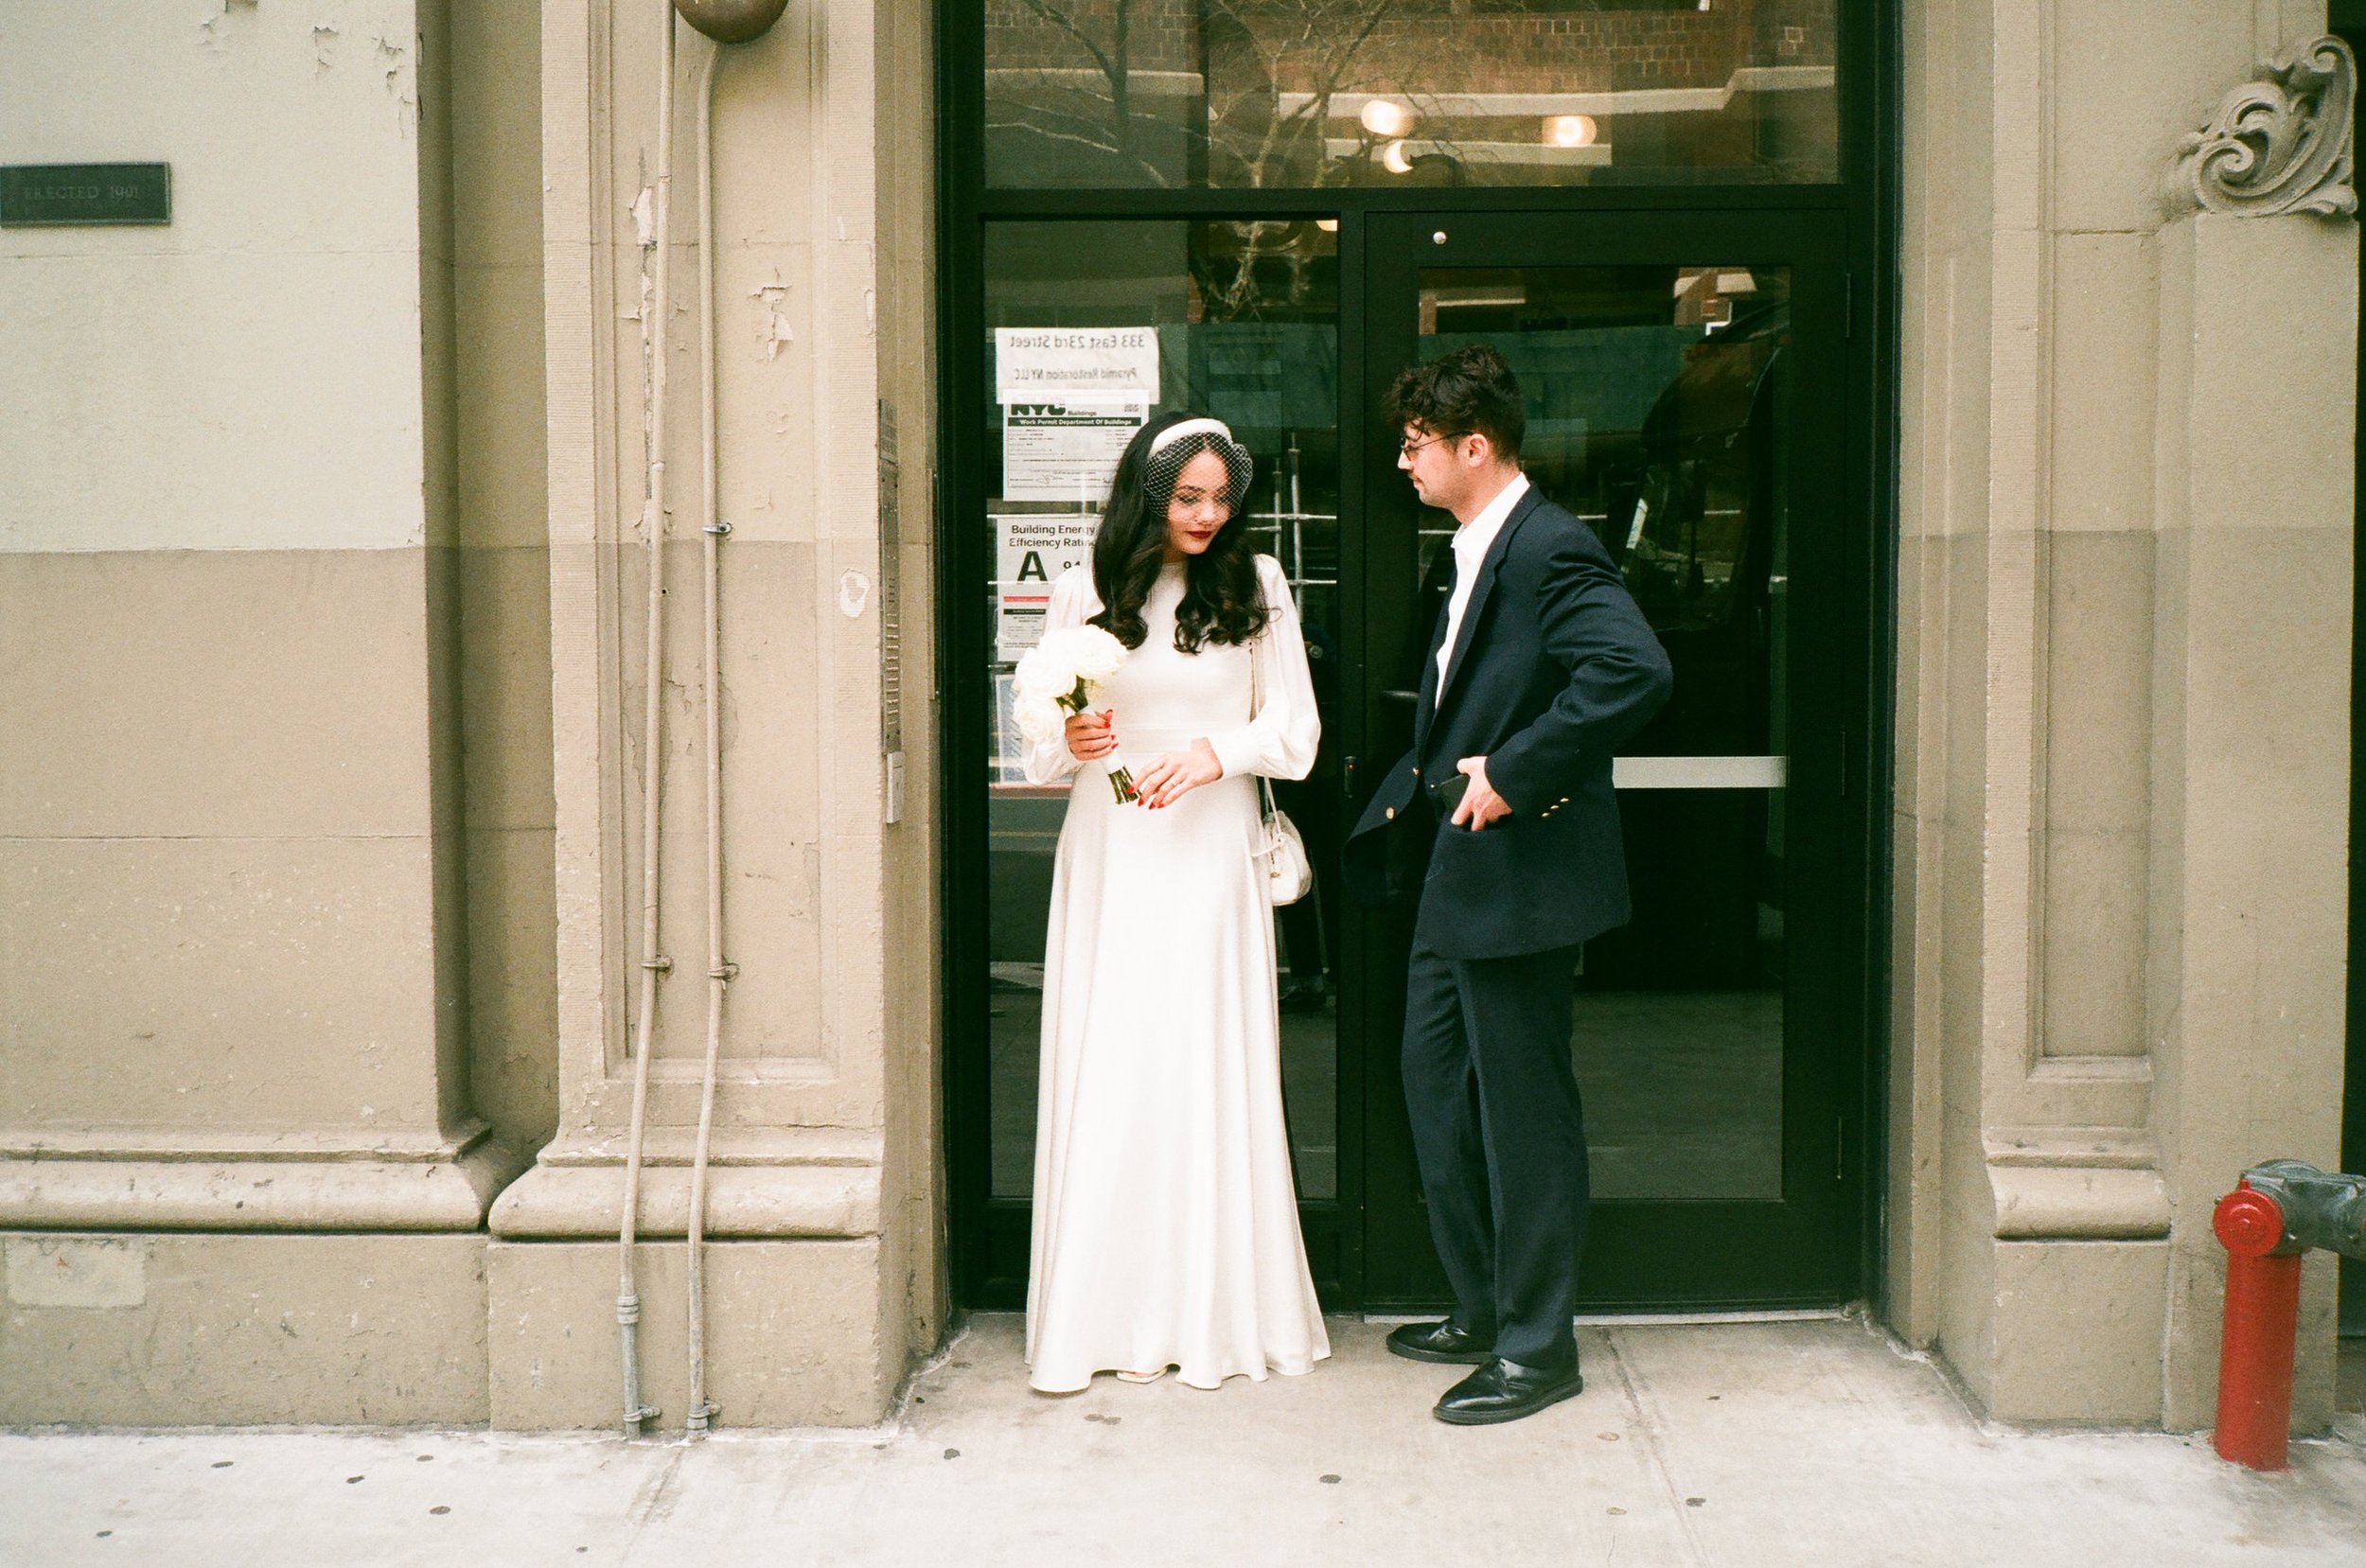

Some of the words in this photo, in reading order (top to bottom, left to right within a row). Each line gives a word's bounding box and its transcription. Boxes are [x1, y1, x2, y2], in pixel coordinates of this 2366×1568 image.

[24, 185, 99, 200] ERECTED
[1012, 524, 1055, 536] Building
[1009, 537, 1061, 549] Efficiency
[1017, 551, 1048, 582] A
